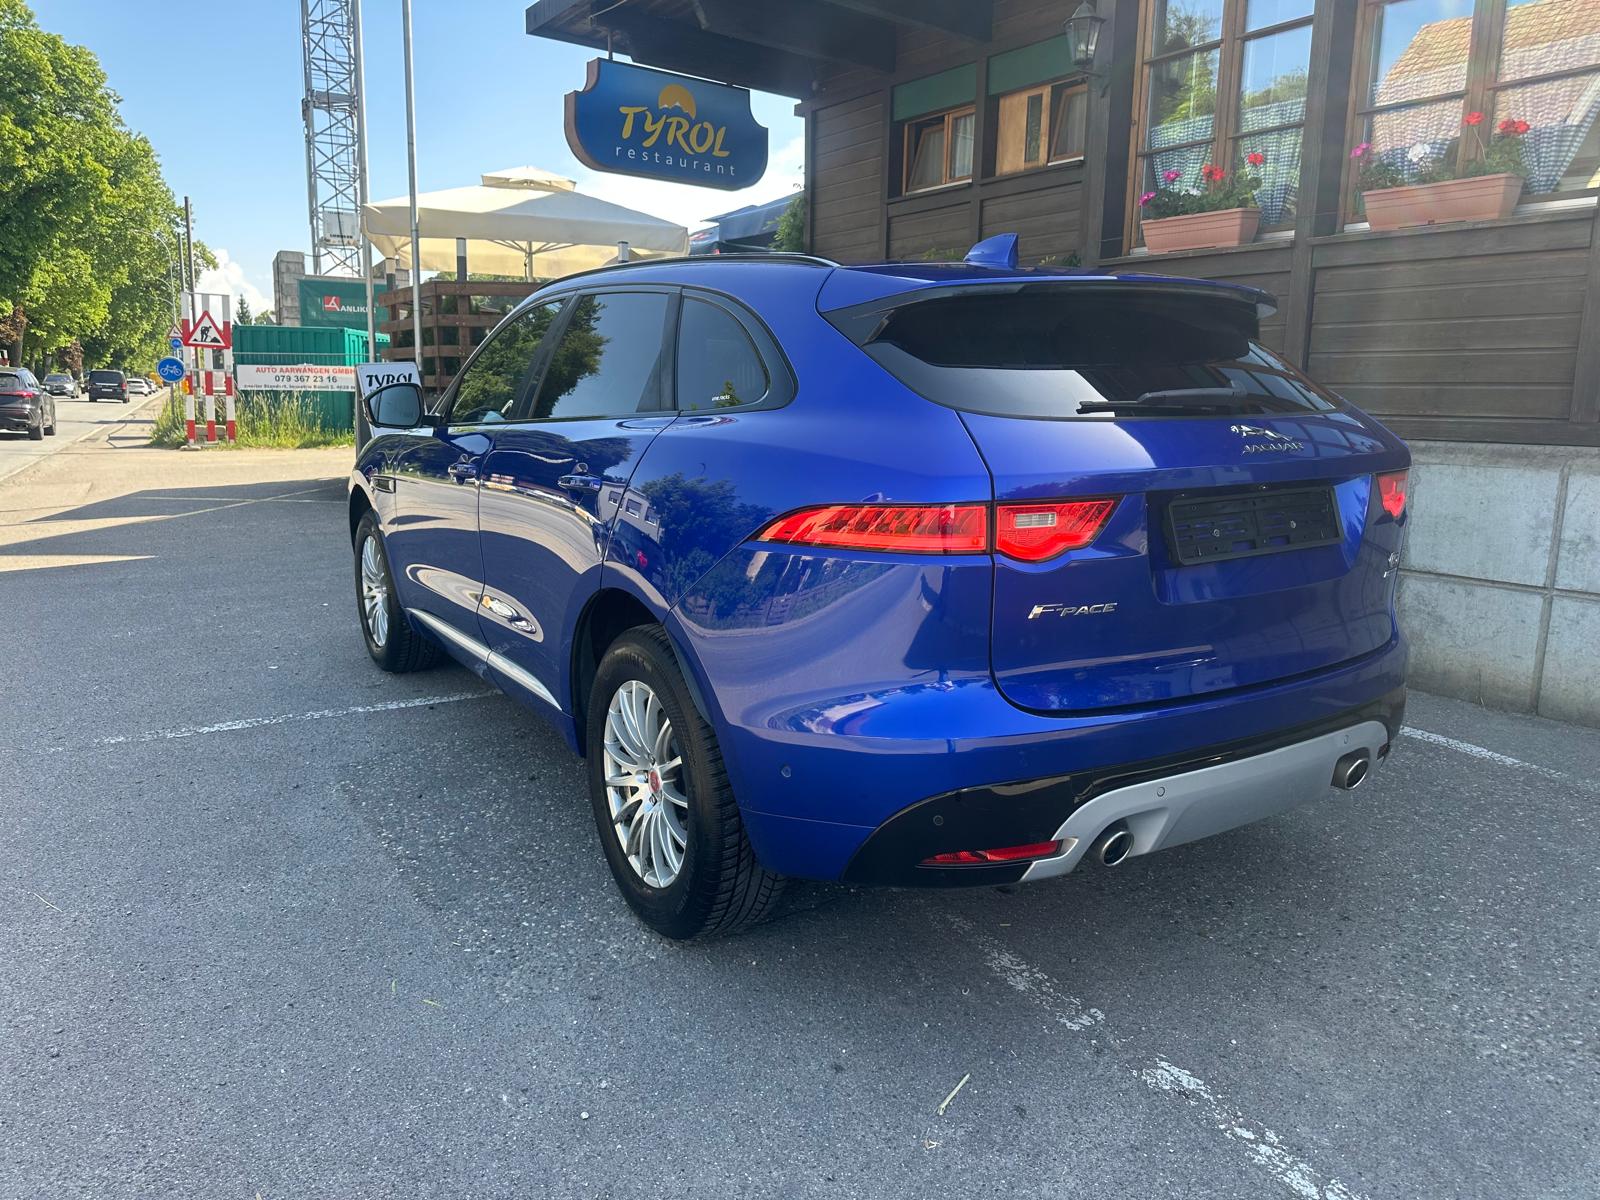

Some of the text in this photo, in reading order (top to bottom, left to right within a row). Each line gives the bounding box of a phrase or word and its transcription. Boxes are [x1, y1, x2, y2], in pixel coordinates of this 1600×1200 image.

[619, 106, 730, 157] TYROL
[616, 145, 735, 176] restaurant
[279, 366, 330, 374] AARWANGEN
[274, 375, 291, 383] 079
[294, 375, 310, 383] 367
[313, 375, 324, 383] 23
[1241, 442, 1305, 456] JAGUAR
[1028, 602, 1118, 619] F-PACE
